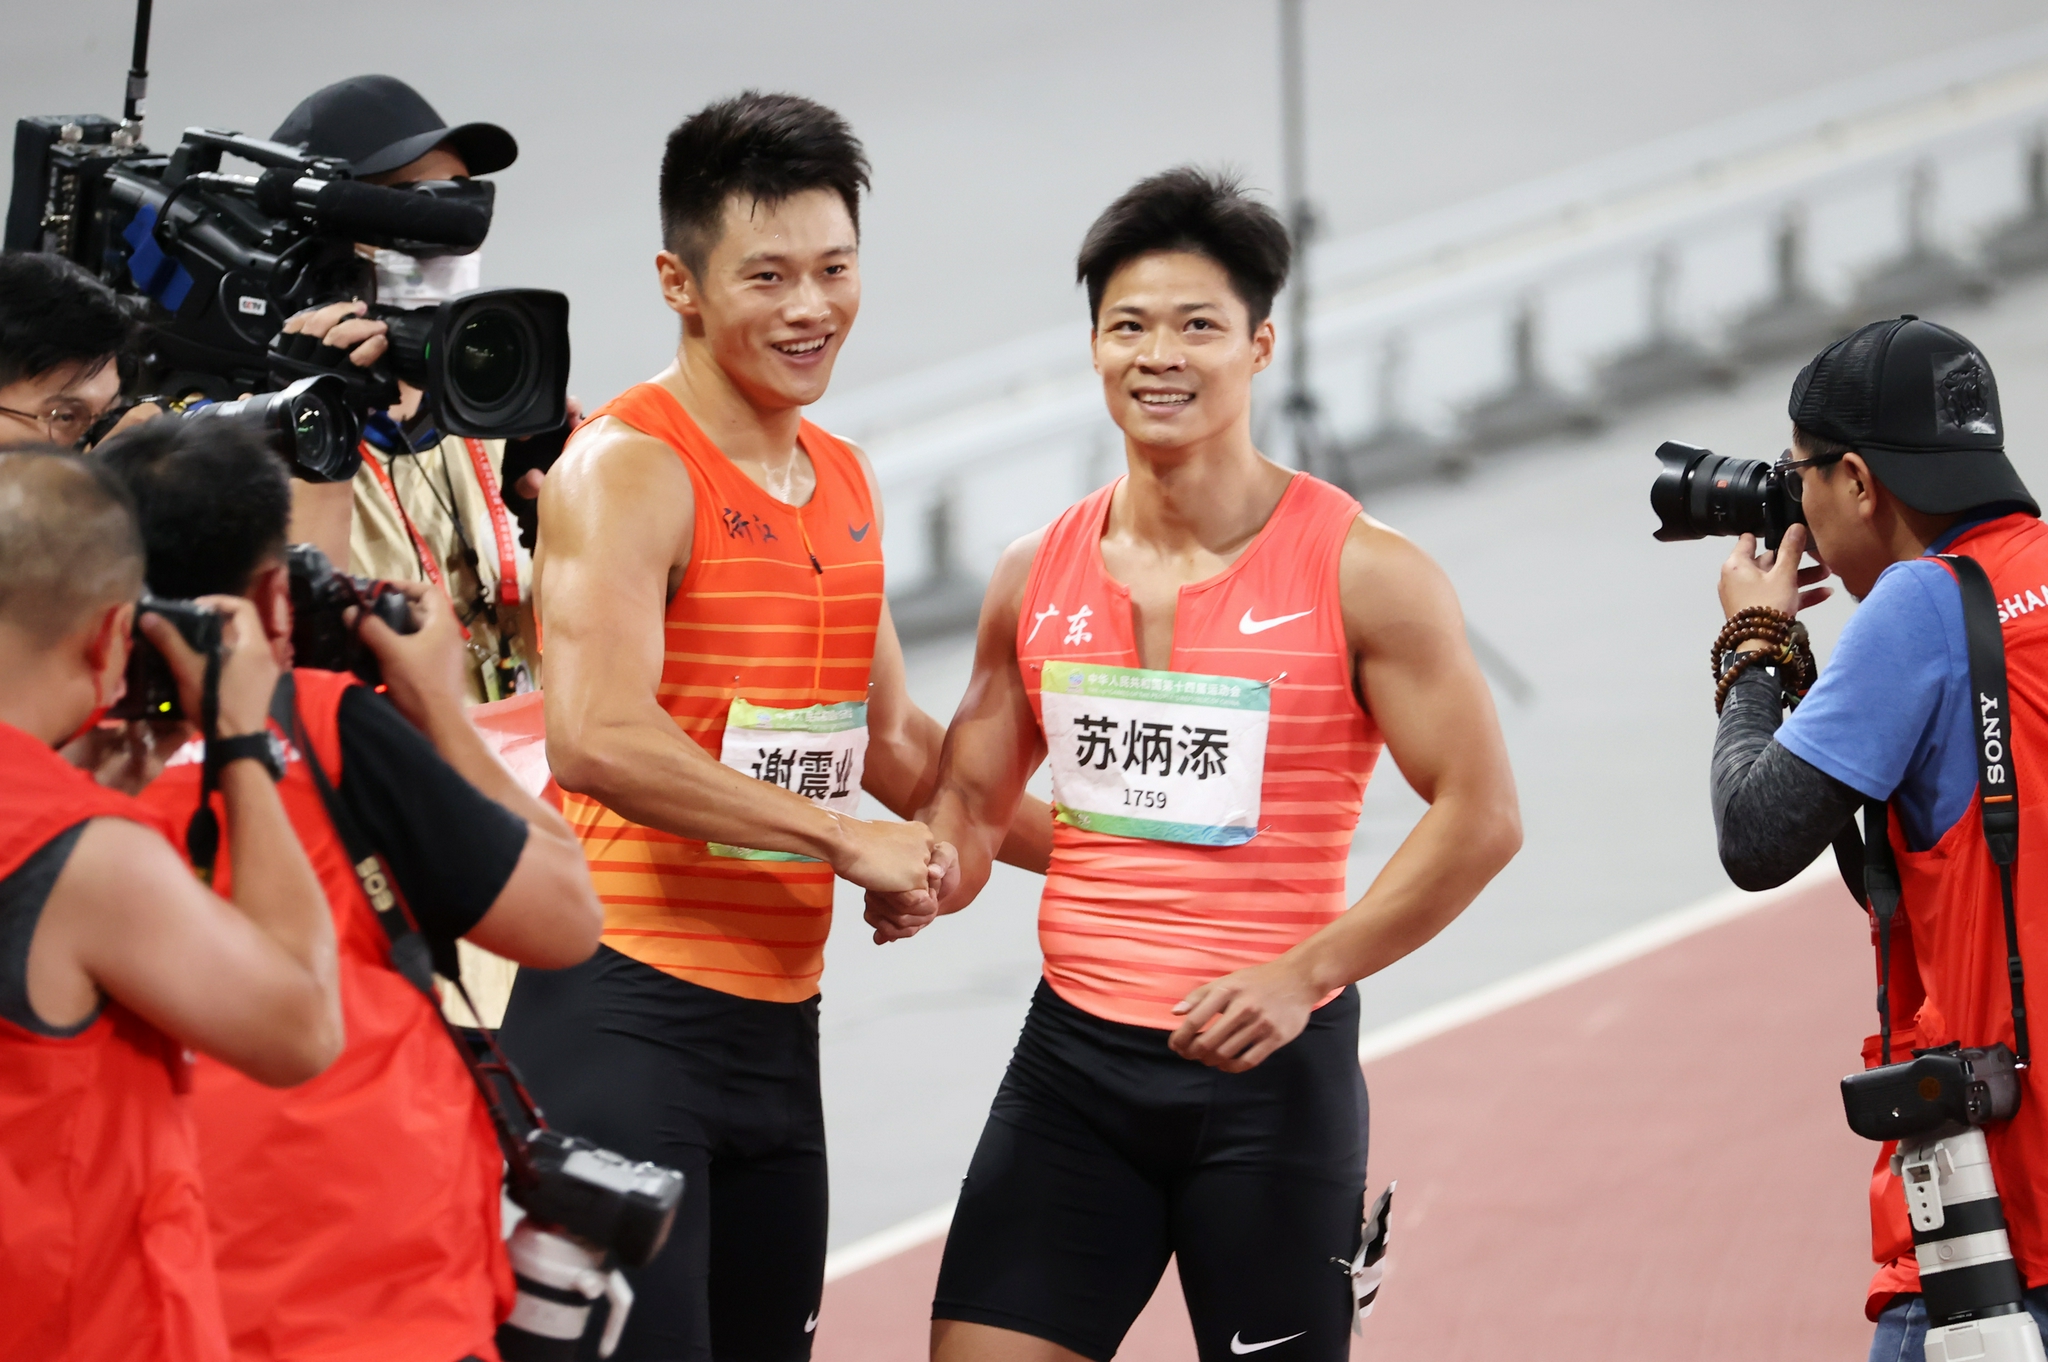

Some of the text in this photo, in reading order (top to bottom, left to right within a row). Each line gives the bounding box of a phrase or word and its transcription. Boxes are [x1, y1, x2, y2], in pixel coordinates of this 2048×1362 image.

[1025, 603, 1094, 646] 广东
[1074, 714, 1229, 780] 苏炳添
[1980, 692, 2005, 784] SONY
[1123, 788, 1168, 809] 1759
